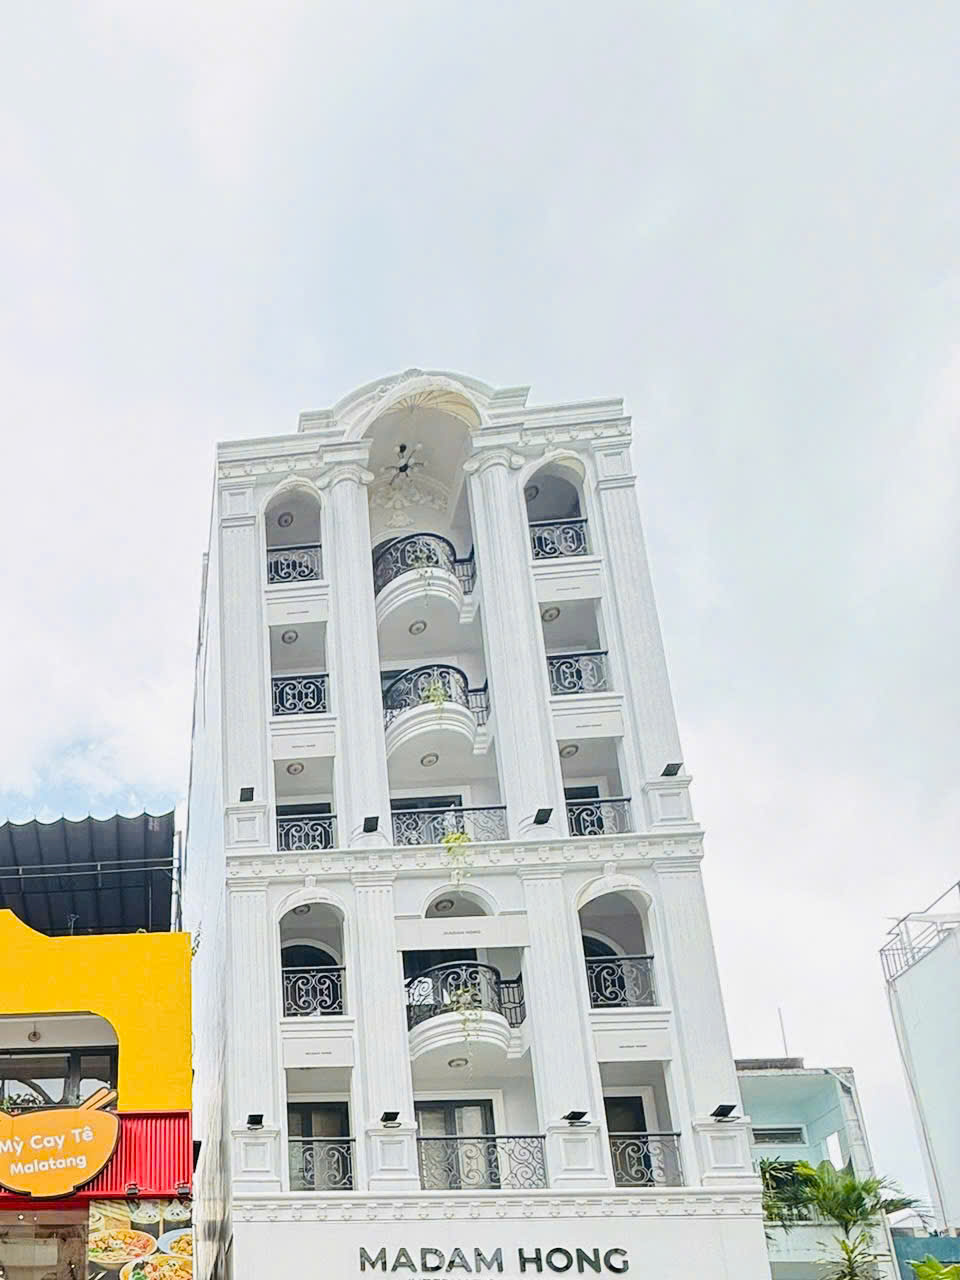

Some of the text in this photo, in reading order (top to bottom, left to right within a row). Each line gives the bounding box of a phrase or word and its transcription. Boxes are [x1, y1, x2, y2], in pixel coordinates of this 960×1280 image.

[30, 1134, 65, 1149] Cay
[71, 1125, 94, 1144] Tê
[10, 1154, 87, 1176] Malatang
[358, 1246, 630, 1274] MADAM HONG
